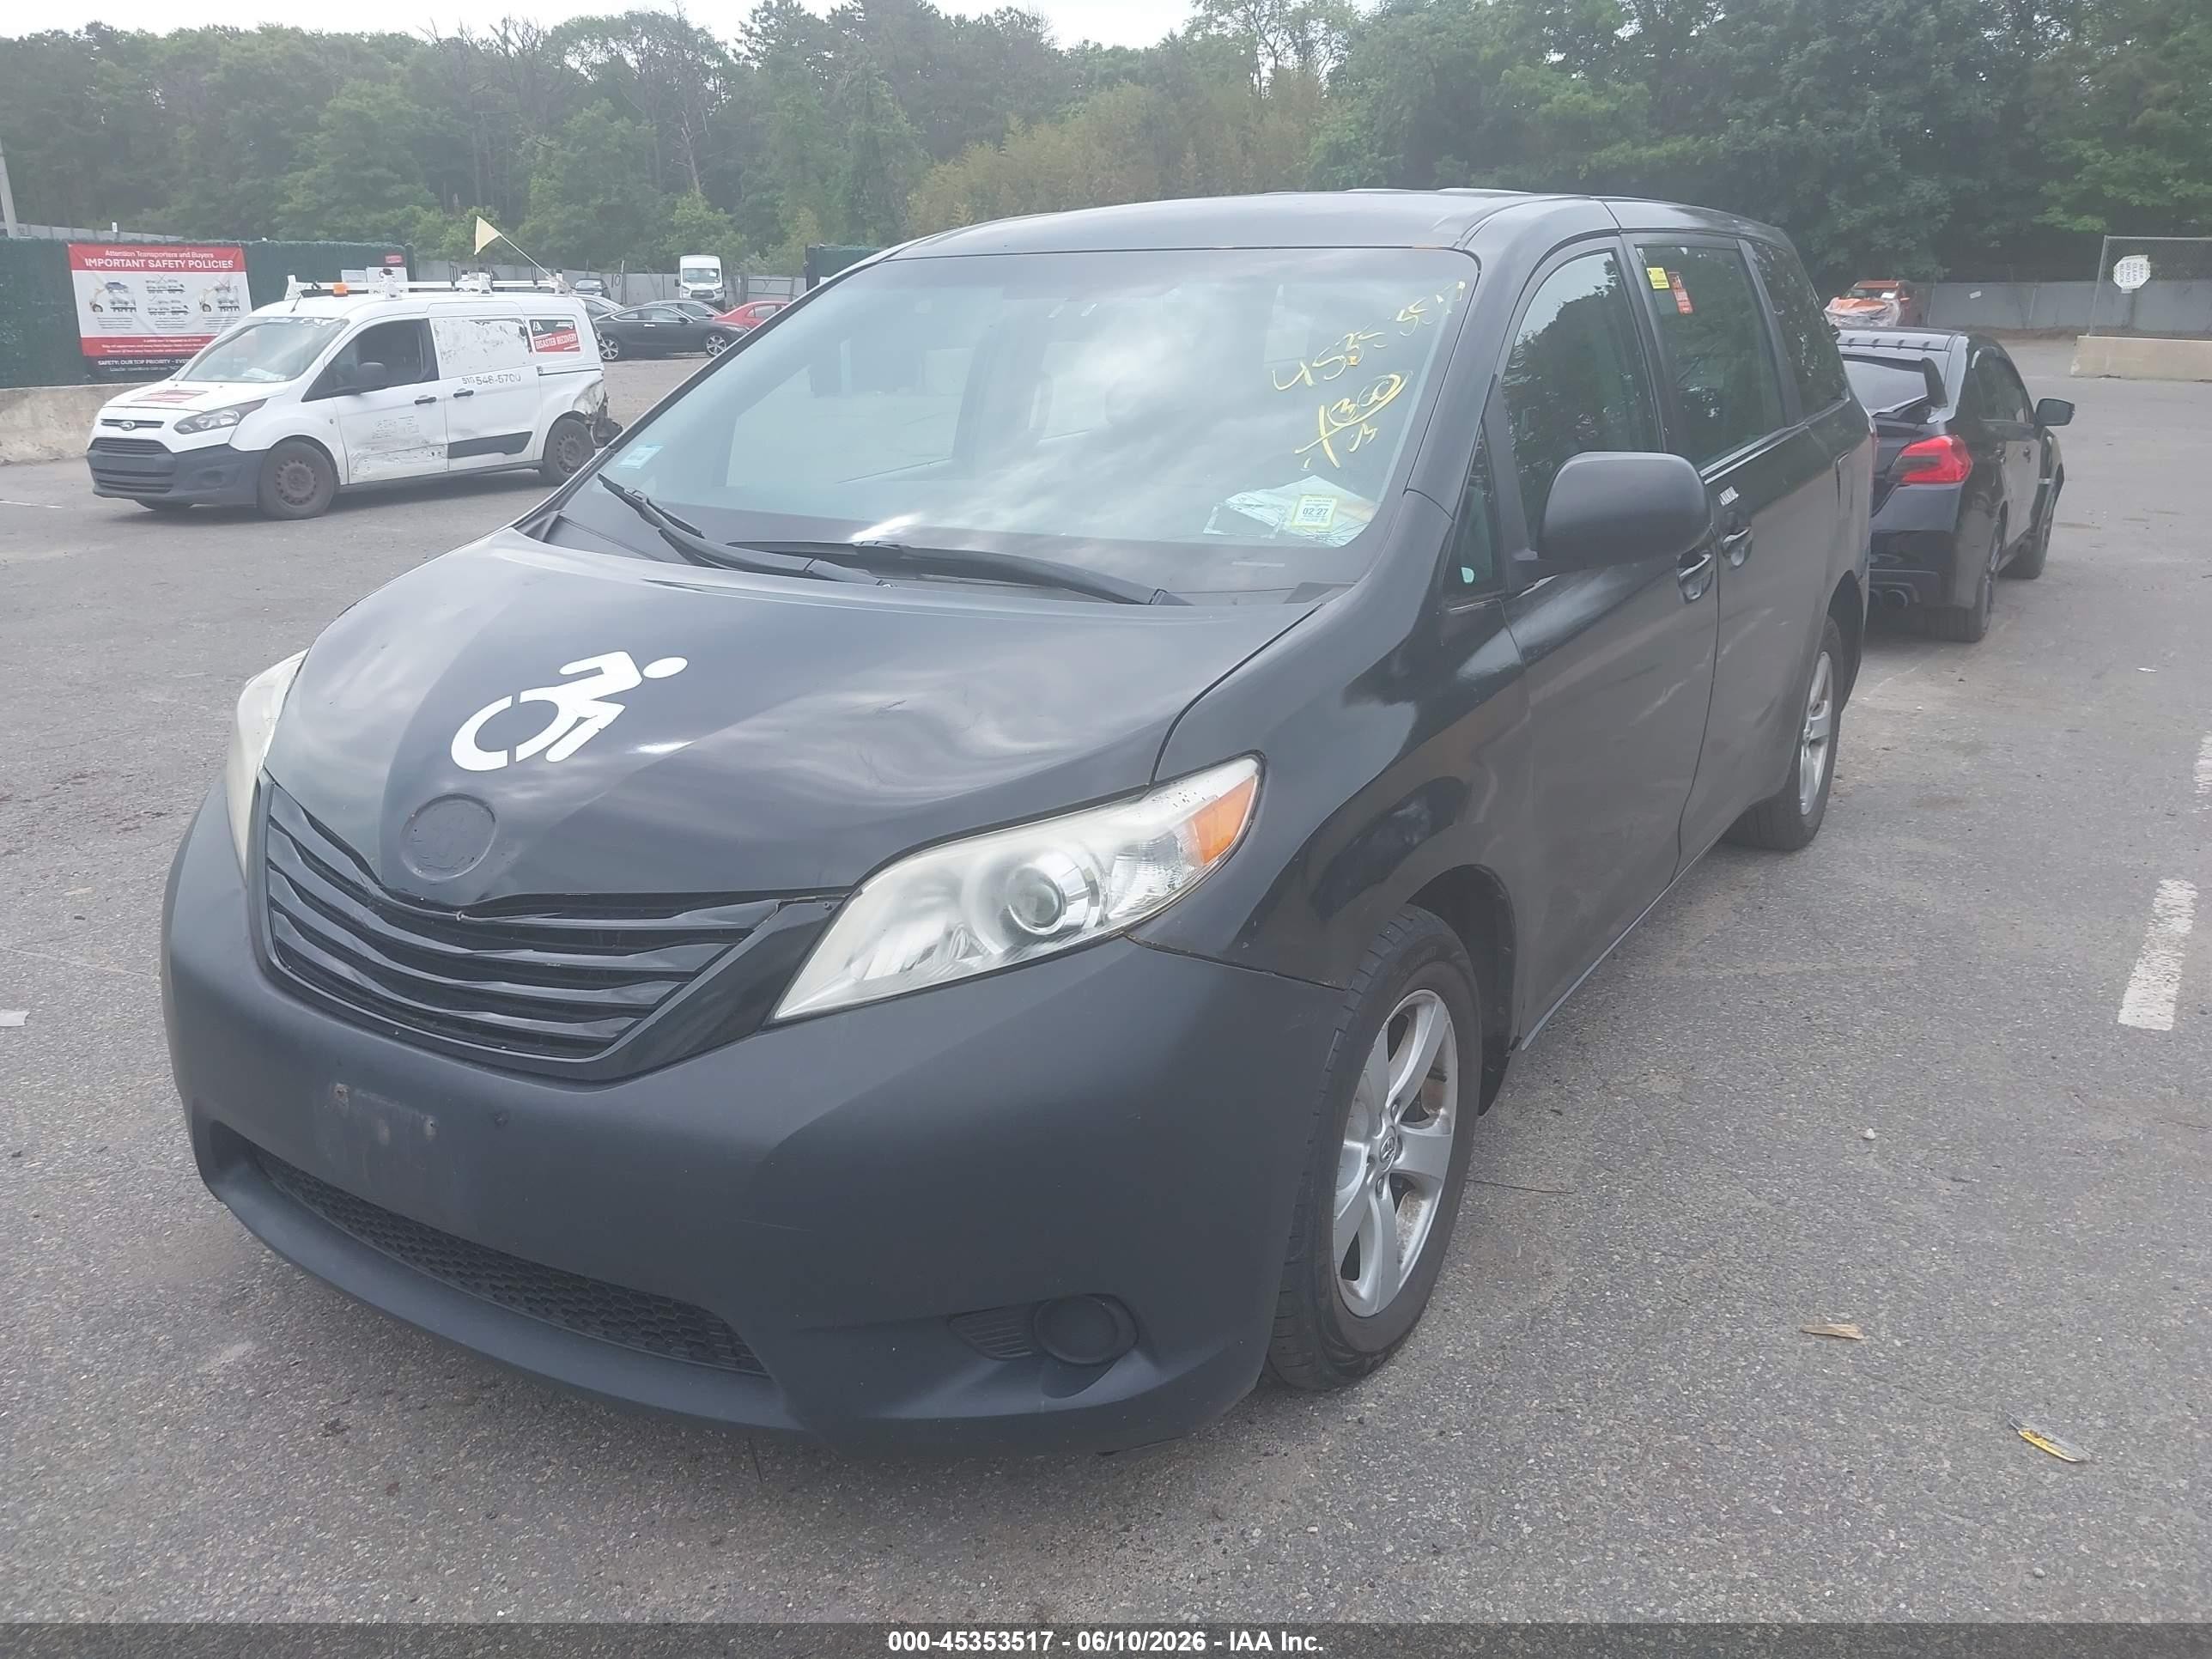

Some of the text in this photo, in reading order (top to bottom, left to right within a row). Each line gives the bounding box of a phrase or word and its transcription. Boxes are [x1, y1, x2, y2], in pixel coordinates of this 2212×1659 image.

[137, 250, 178, 258] Transporters
[85, 258, 234, 269] IMPORTANT SAFETY POLICIES
